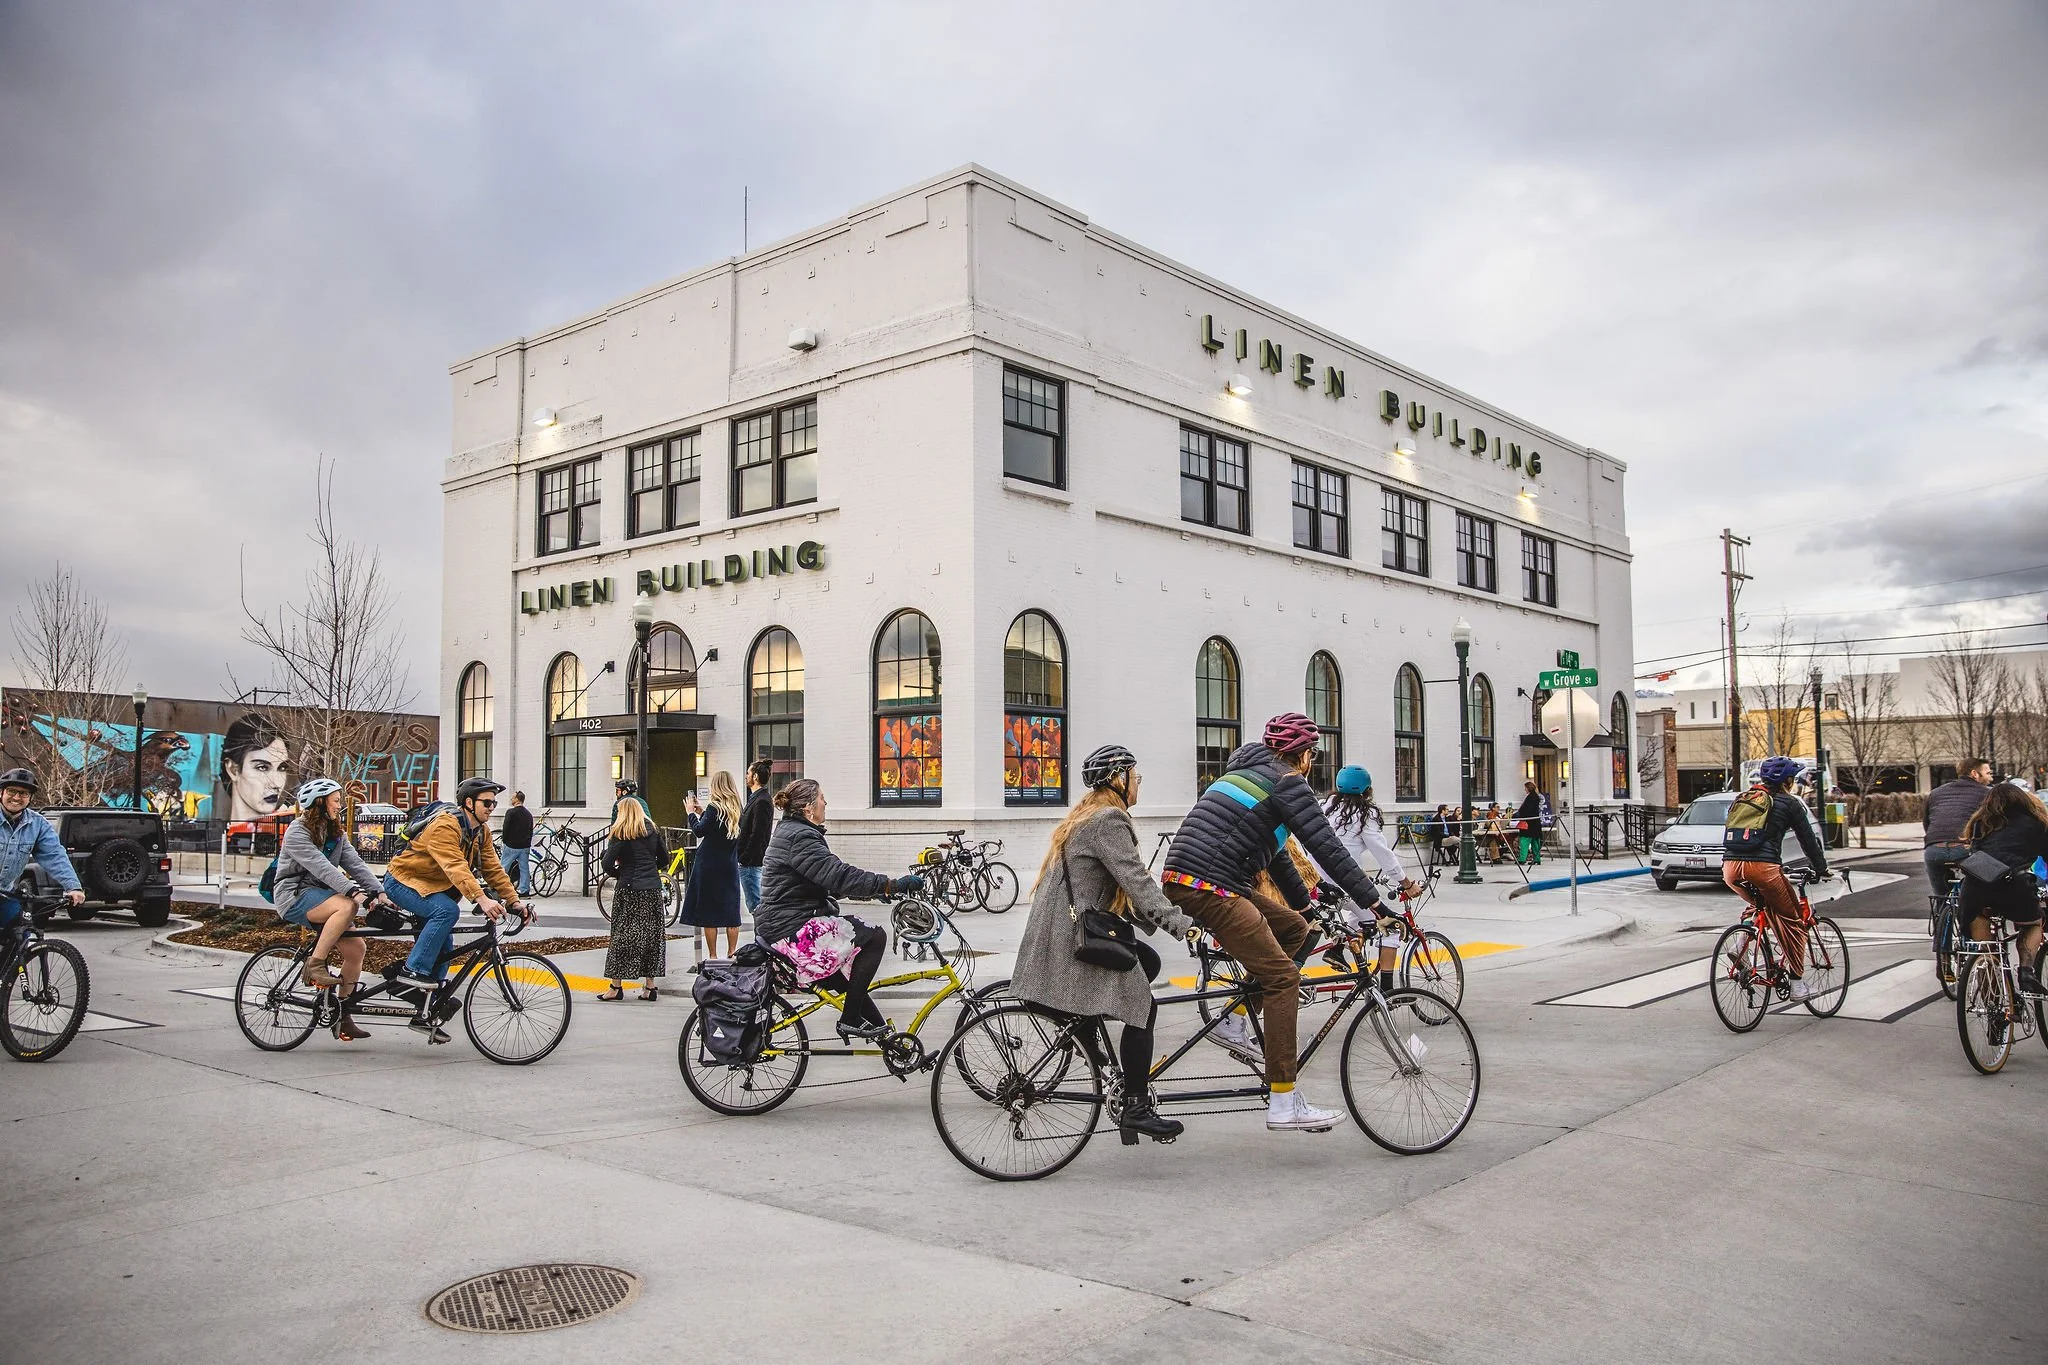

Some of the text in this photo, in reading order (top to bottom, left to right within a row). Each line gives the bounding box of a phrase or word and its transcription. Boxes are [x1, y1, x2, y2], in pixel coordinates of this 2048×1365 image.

[1201, 314, 1542, 477] LINEN BUILDING
[521, 540, 825, 615] LINEN BUILDING
[1553, 673, 1580, 687] Grove
[579, 719, 602, 730] 1402
